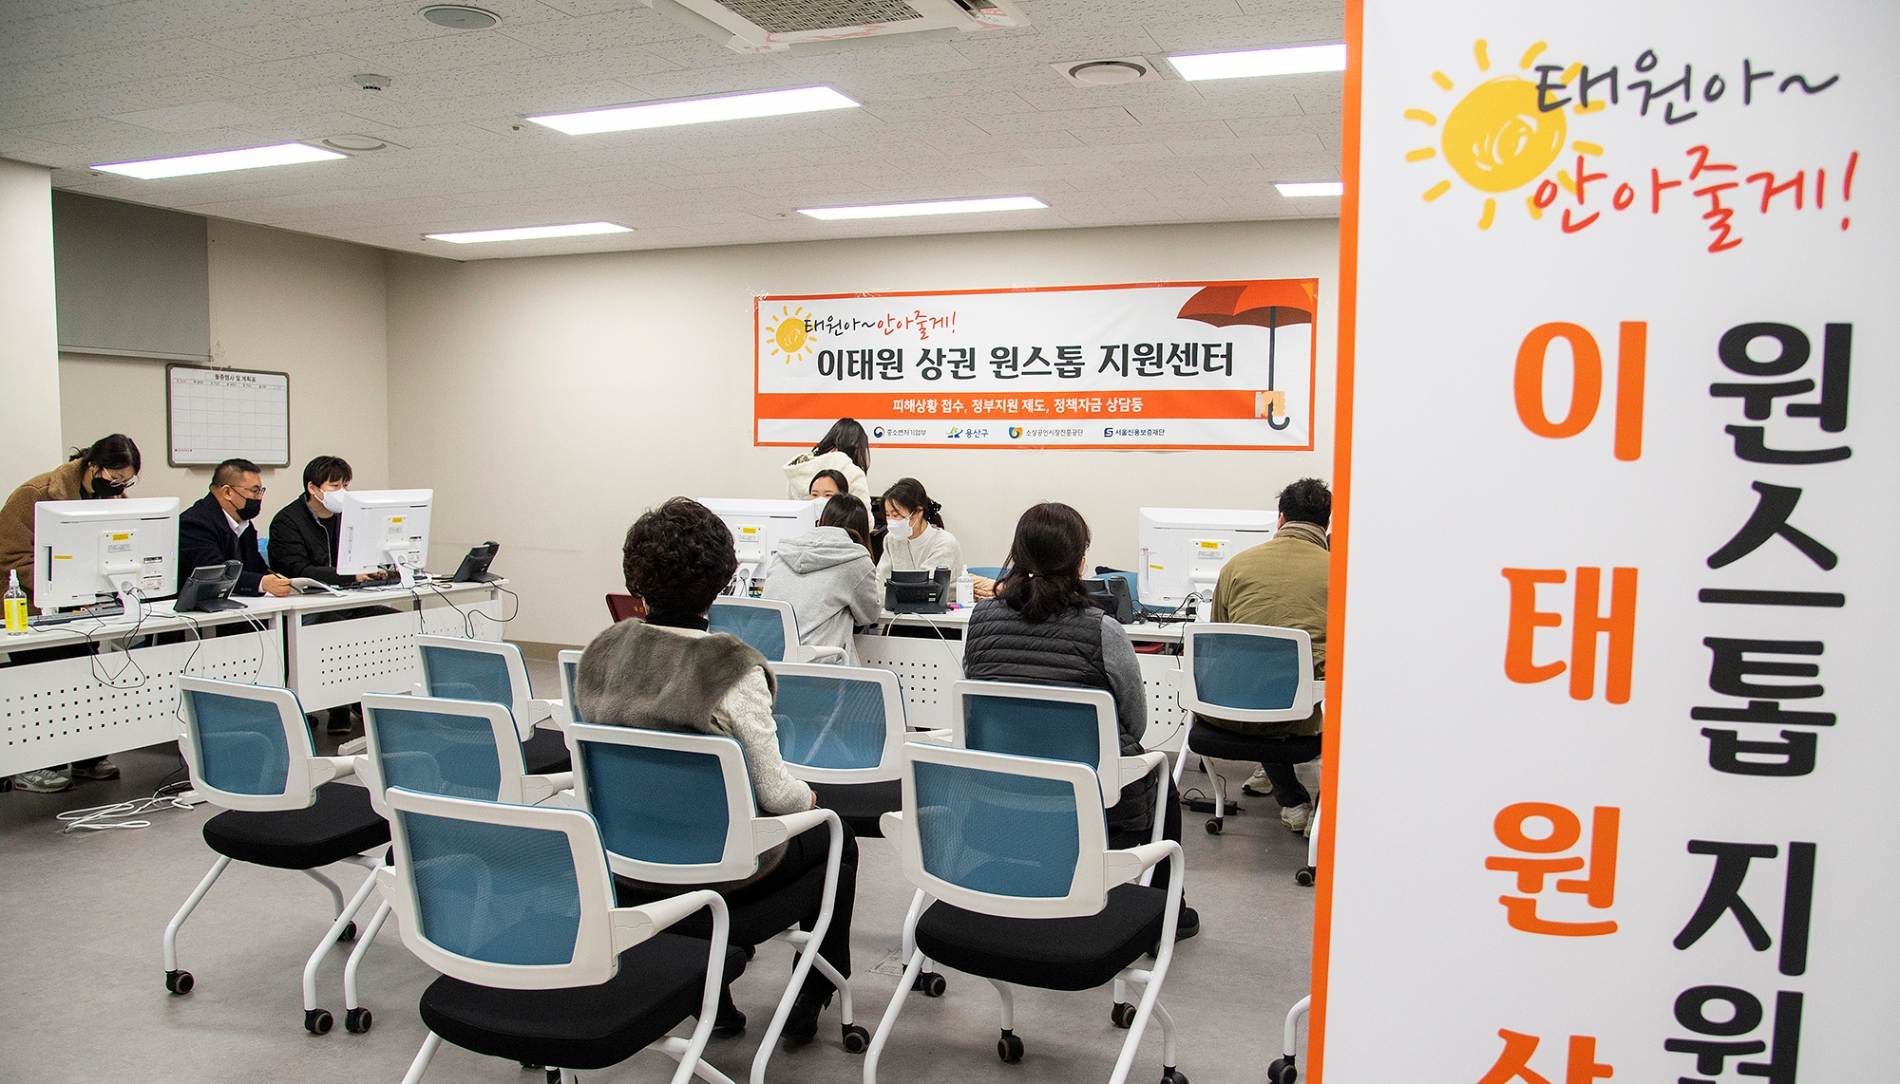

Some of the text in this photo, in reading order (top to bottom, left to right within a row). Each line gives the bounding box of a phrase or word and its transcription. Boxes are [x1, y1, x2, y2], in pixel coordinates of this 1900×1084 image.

[1532, 145, 1858, 253] 안아줄게!
[817, 342, 1233, 381] 이태원 상권 원스톱 지원센터
[892, 397, 1144, 414] 피해상황 접수, 정부지원 제도, 정책자금 상담등
[965, 428, 989, 439] 용산구
[1115, 428, 1165, 437] 서울신용보증재단
[1690, 322, 1853, 777] 원스톱
[1485, 320, 1648, 938] 이태원
